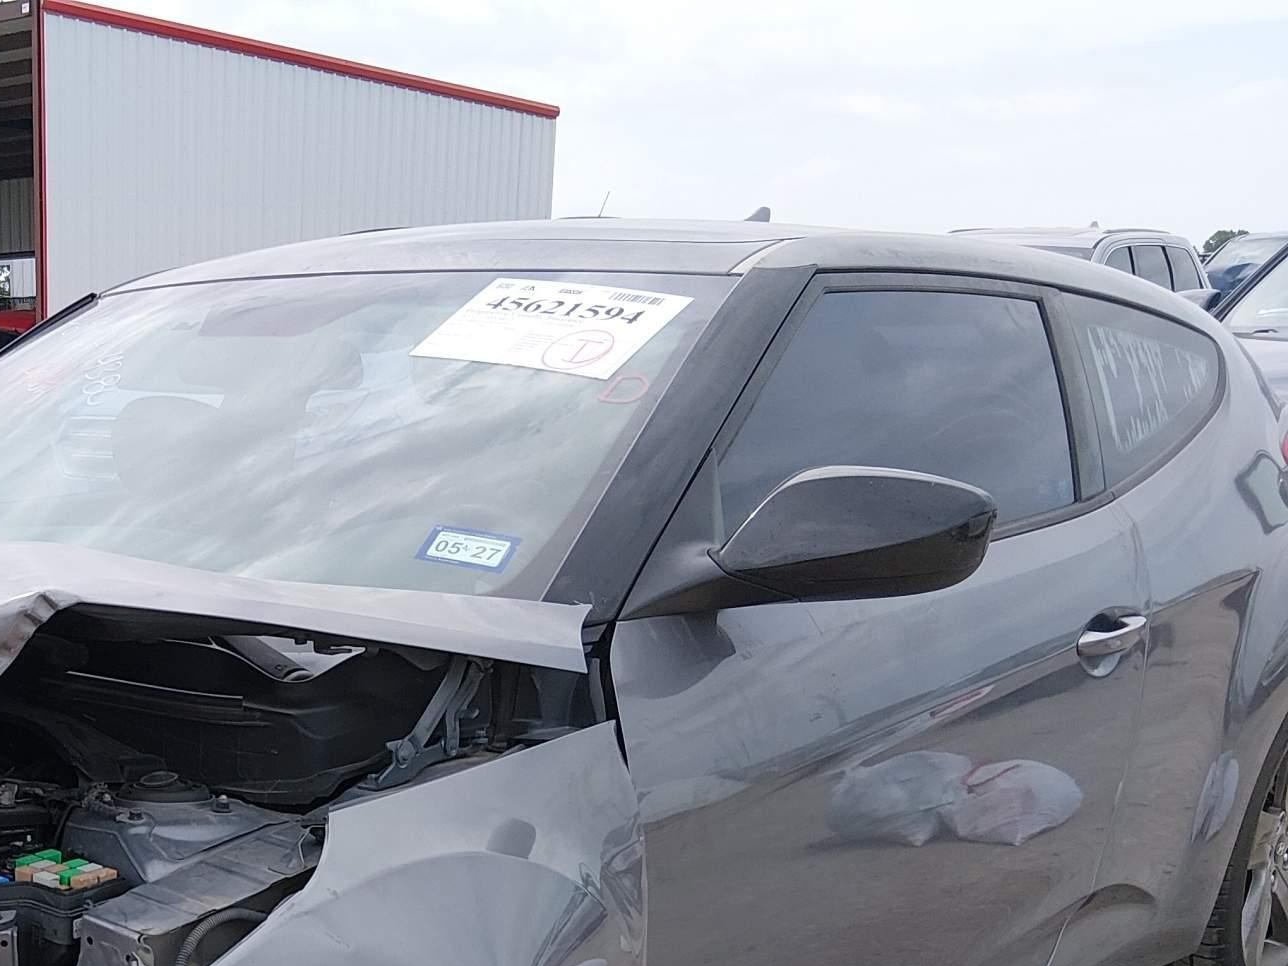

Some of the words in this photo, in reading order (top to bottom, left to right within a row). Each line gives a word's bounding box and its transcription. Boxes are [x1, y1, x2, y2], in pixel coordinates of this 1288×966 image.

[486, 297, 645, 325] 45621594
[435, 540, 464, 555] 05
[470, 545, 502, 561] 27
